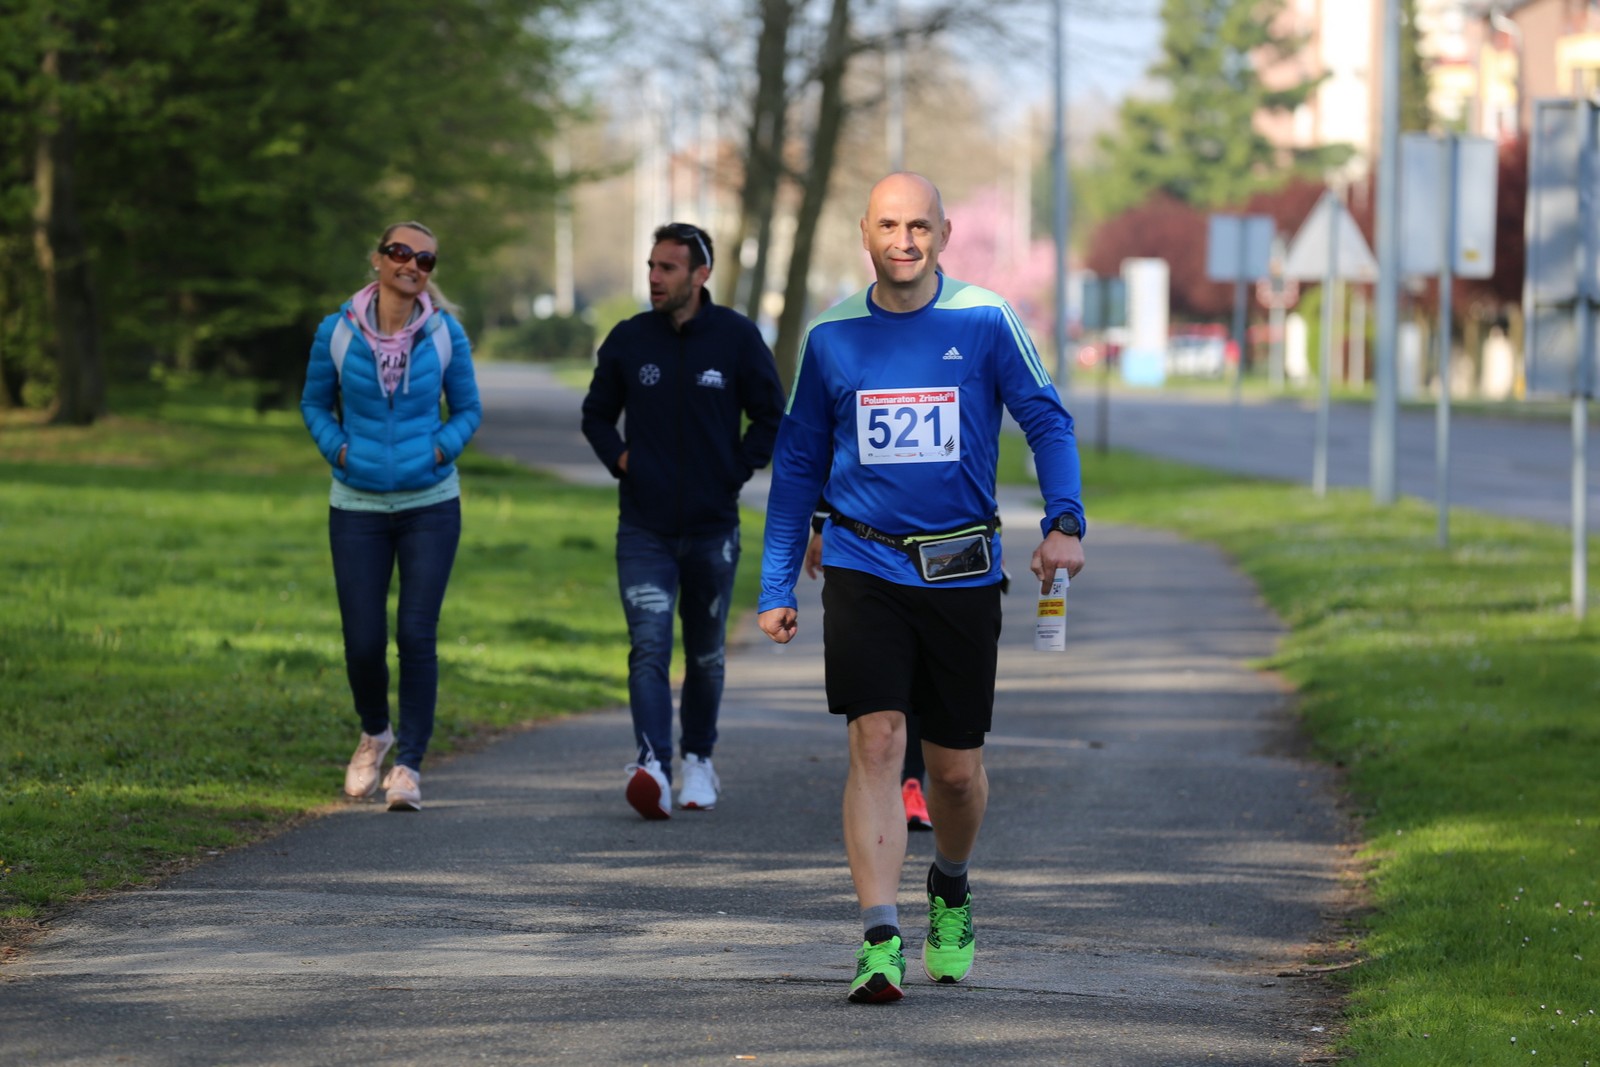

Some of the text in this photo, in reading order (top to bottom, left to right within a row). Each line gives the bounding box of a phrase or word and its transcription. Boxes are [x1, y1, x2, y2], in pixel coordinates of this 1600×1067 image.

[863, 396, 916, 405] Polumaraton
[919, 393, 947, 402] Zrinski
[868, 405, 941, 449] 521
